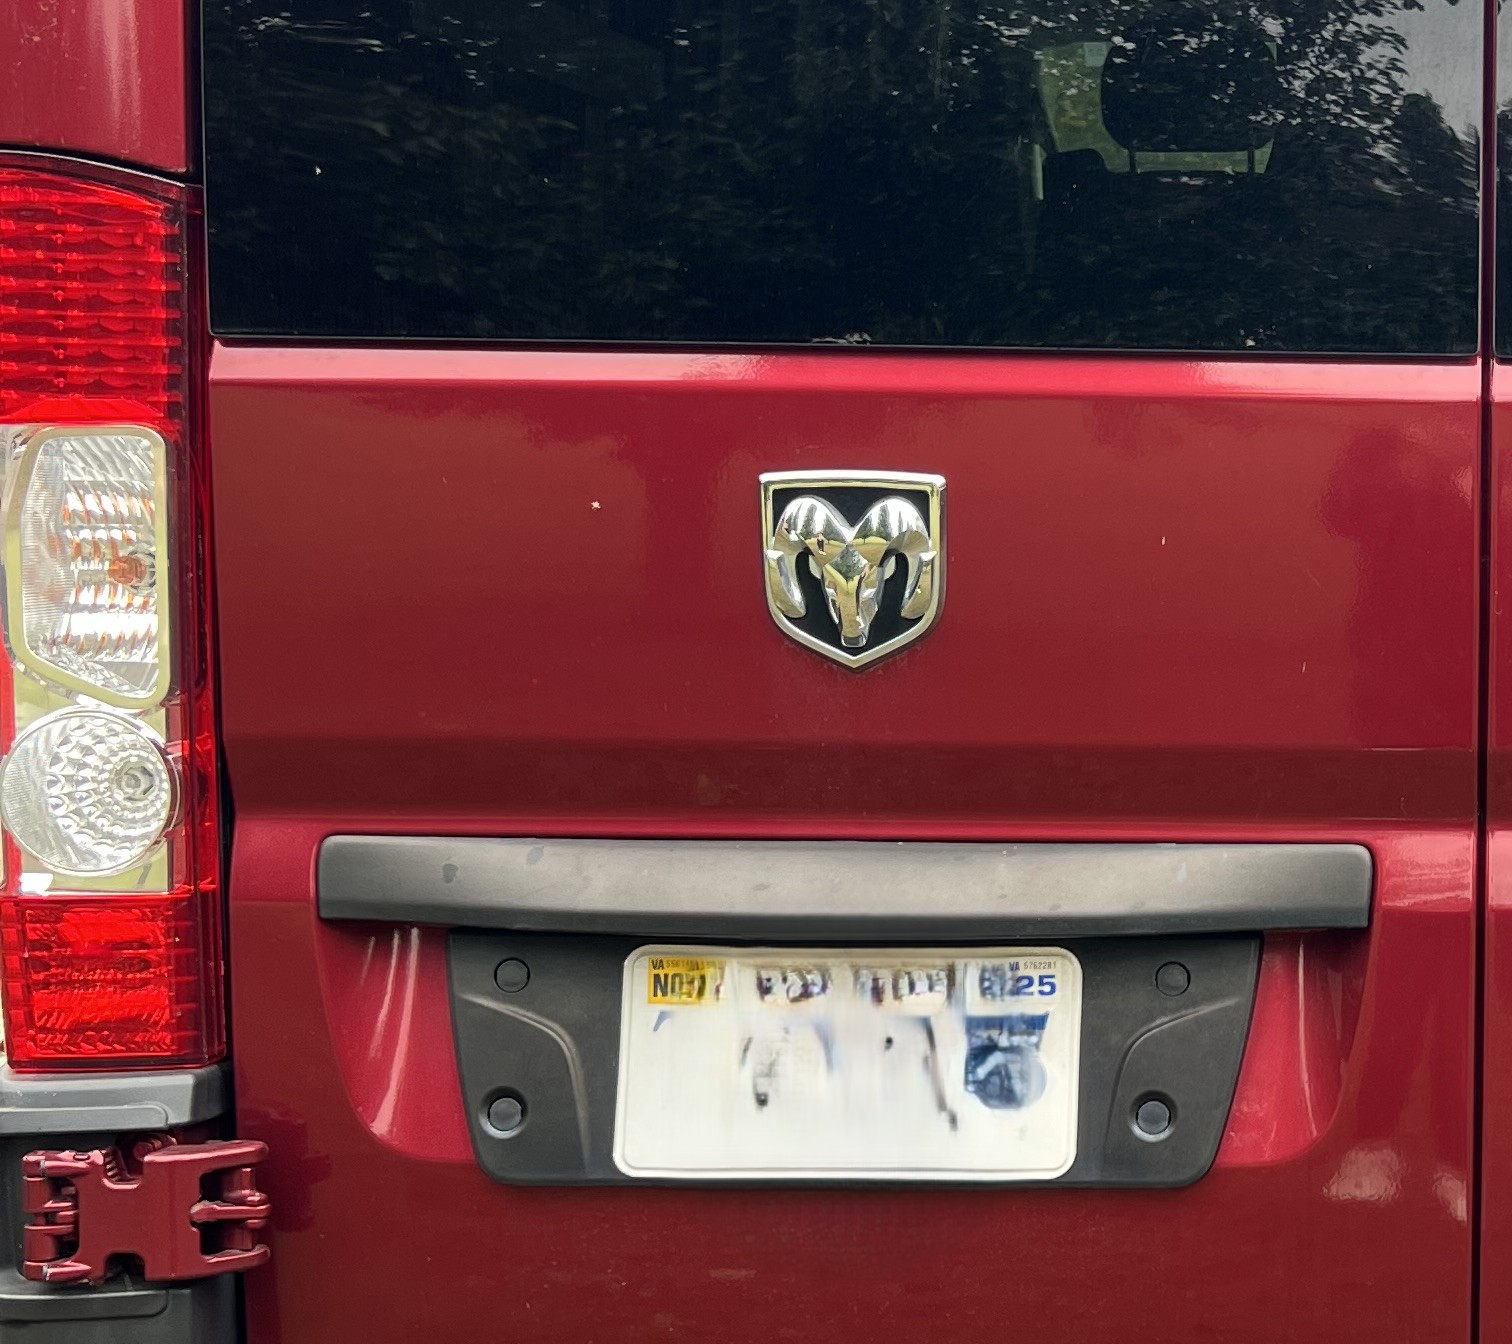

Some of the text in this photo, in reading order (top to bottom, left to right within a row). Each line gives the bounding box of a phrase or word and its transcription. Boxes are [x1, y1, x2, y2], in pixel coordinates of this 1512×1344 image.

[651, 958, 665, 971] VA
[1008, 961, 1020, 971] VA
[1015, 974, 1057, 996] 25
